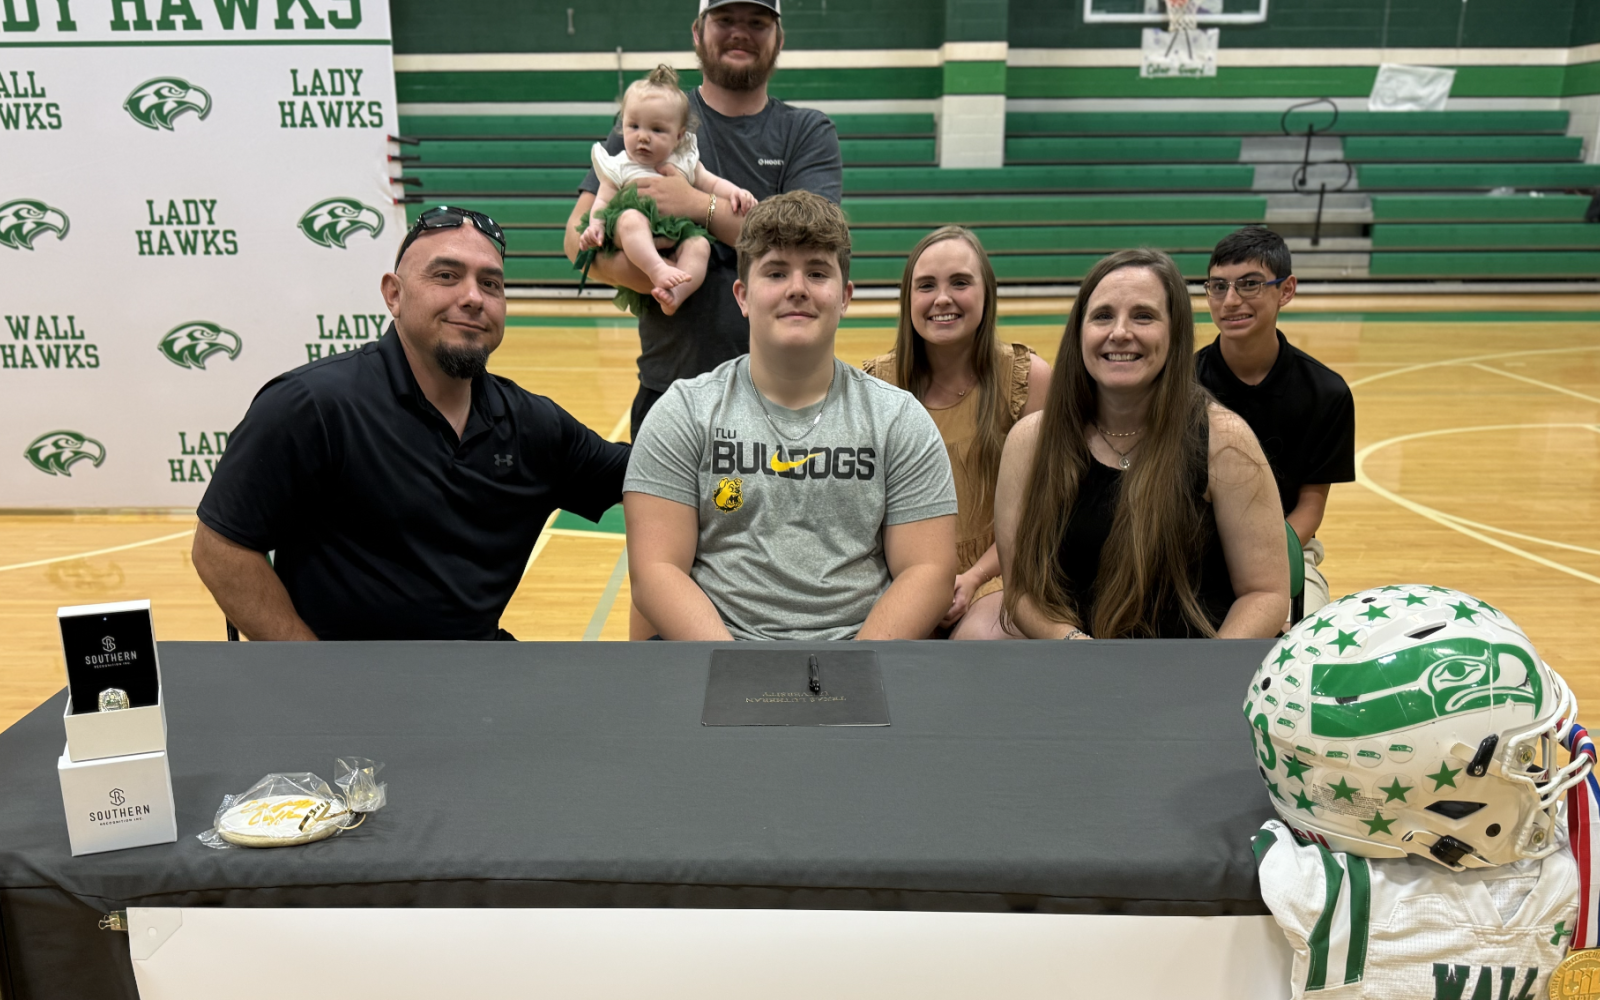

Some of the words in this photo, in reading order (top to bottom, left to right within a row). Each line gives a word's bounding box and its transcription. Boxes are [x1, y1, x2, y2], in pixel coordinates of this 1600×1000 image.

[290, 69, 363, 96] LADY
[278, 101, 384, 128] HAWKS
[146, 199, 218, 225] LADY
[135, 230, 239, 255] HAWKS
[4, 315, 86, 340] WALL
[316, 314, 386, 340] LADY
[0, 344, 100, 368] HAWKS
[715, 427, 737, 440] TLU
[712, 440, 876, 481] BULLDOGS
[84, 650, 138, 665] SOUTHERN
[88, 804, 151, 822] SOUTHERN
